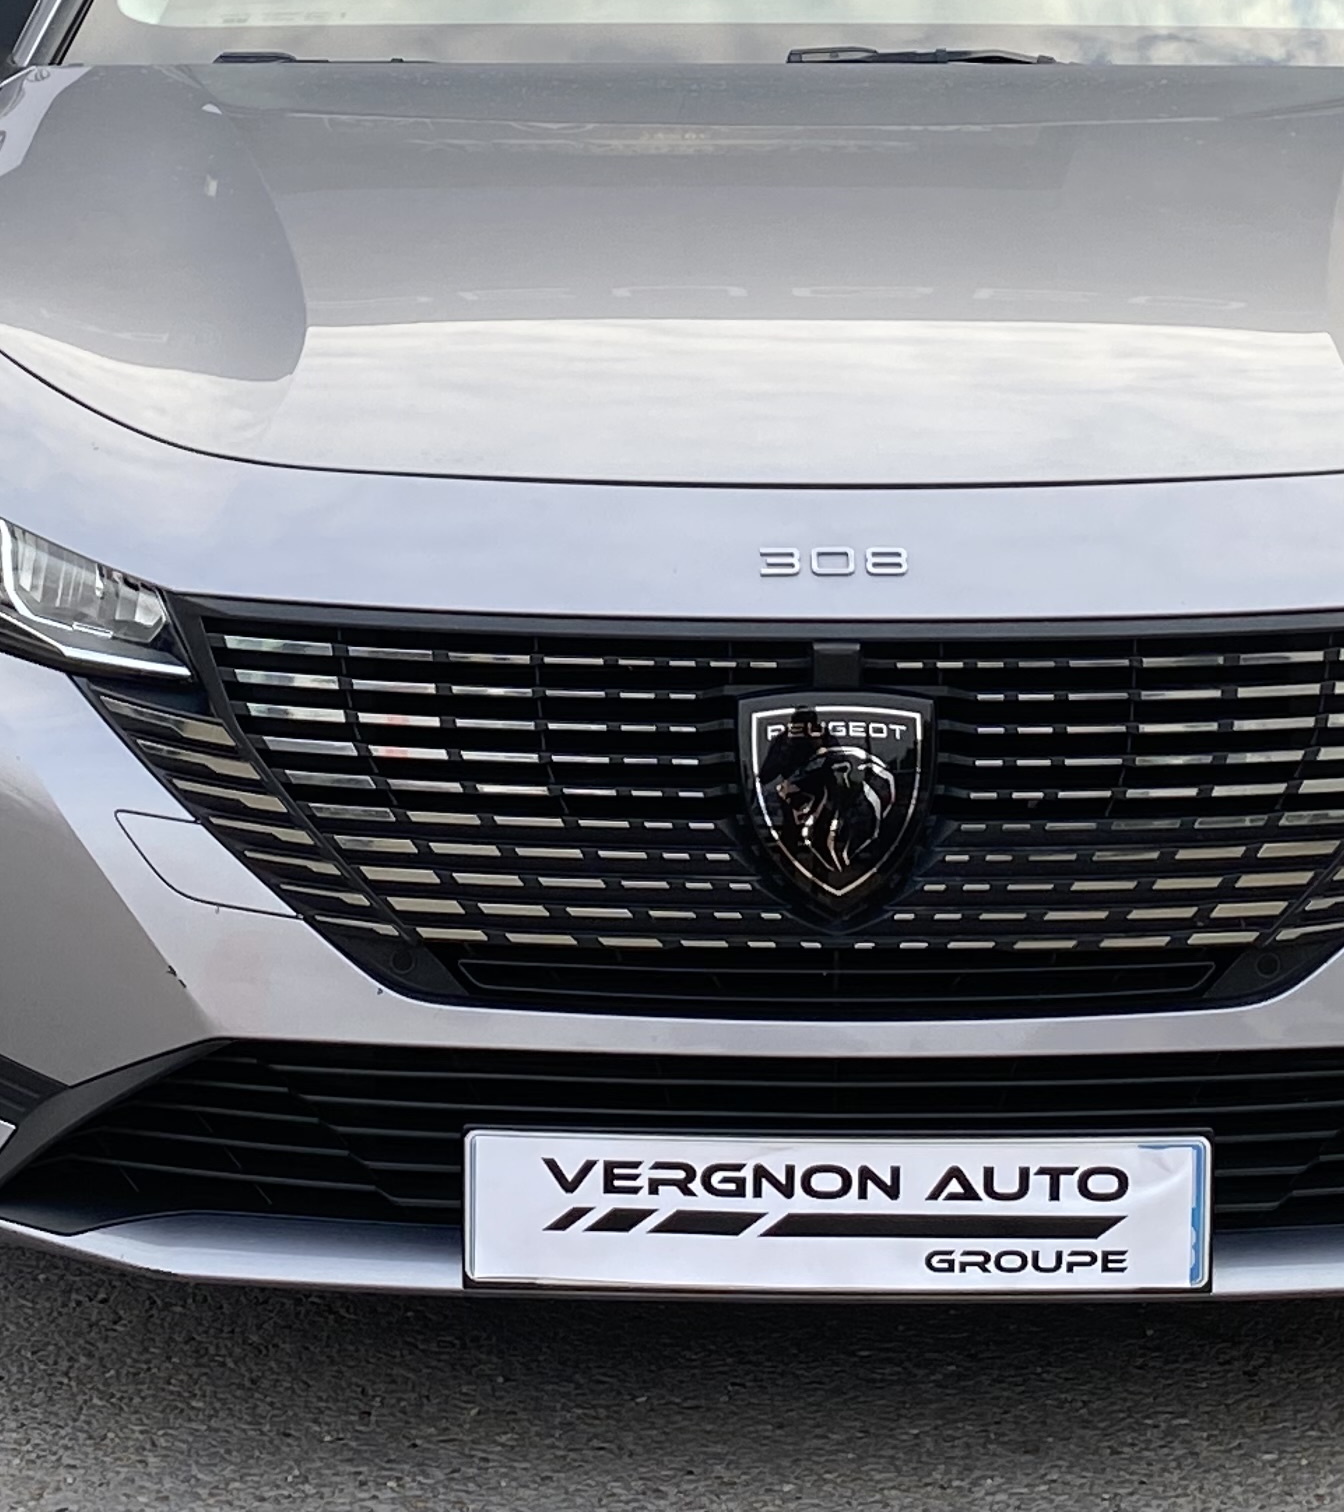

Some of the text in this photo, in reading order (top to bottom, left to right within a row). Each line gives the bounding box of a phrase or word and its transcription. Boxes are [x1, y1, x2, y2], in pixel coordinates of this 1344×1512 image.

[759, 546, 908, 576] 308
[766, 721, 907, 741] PEUGEOT
[541, 1157, 1129, 1202] VERGNON AUTO
[924, 1250, 1128, 1273] GROUPE
